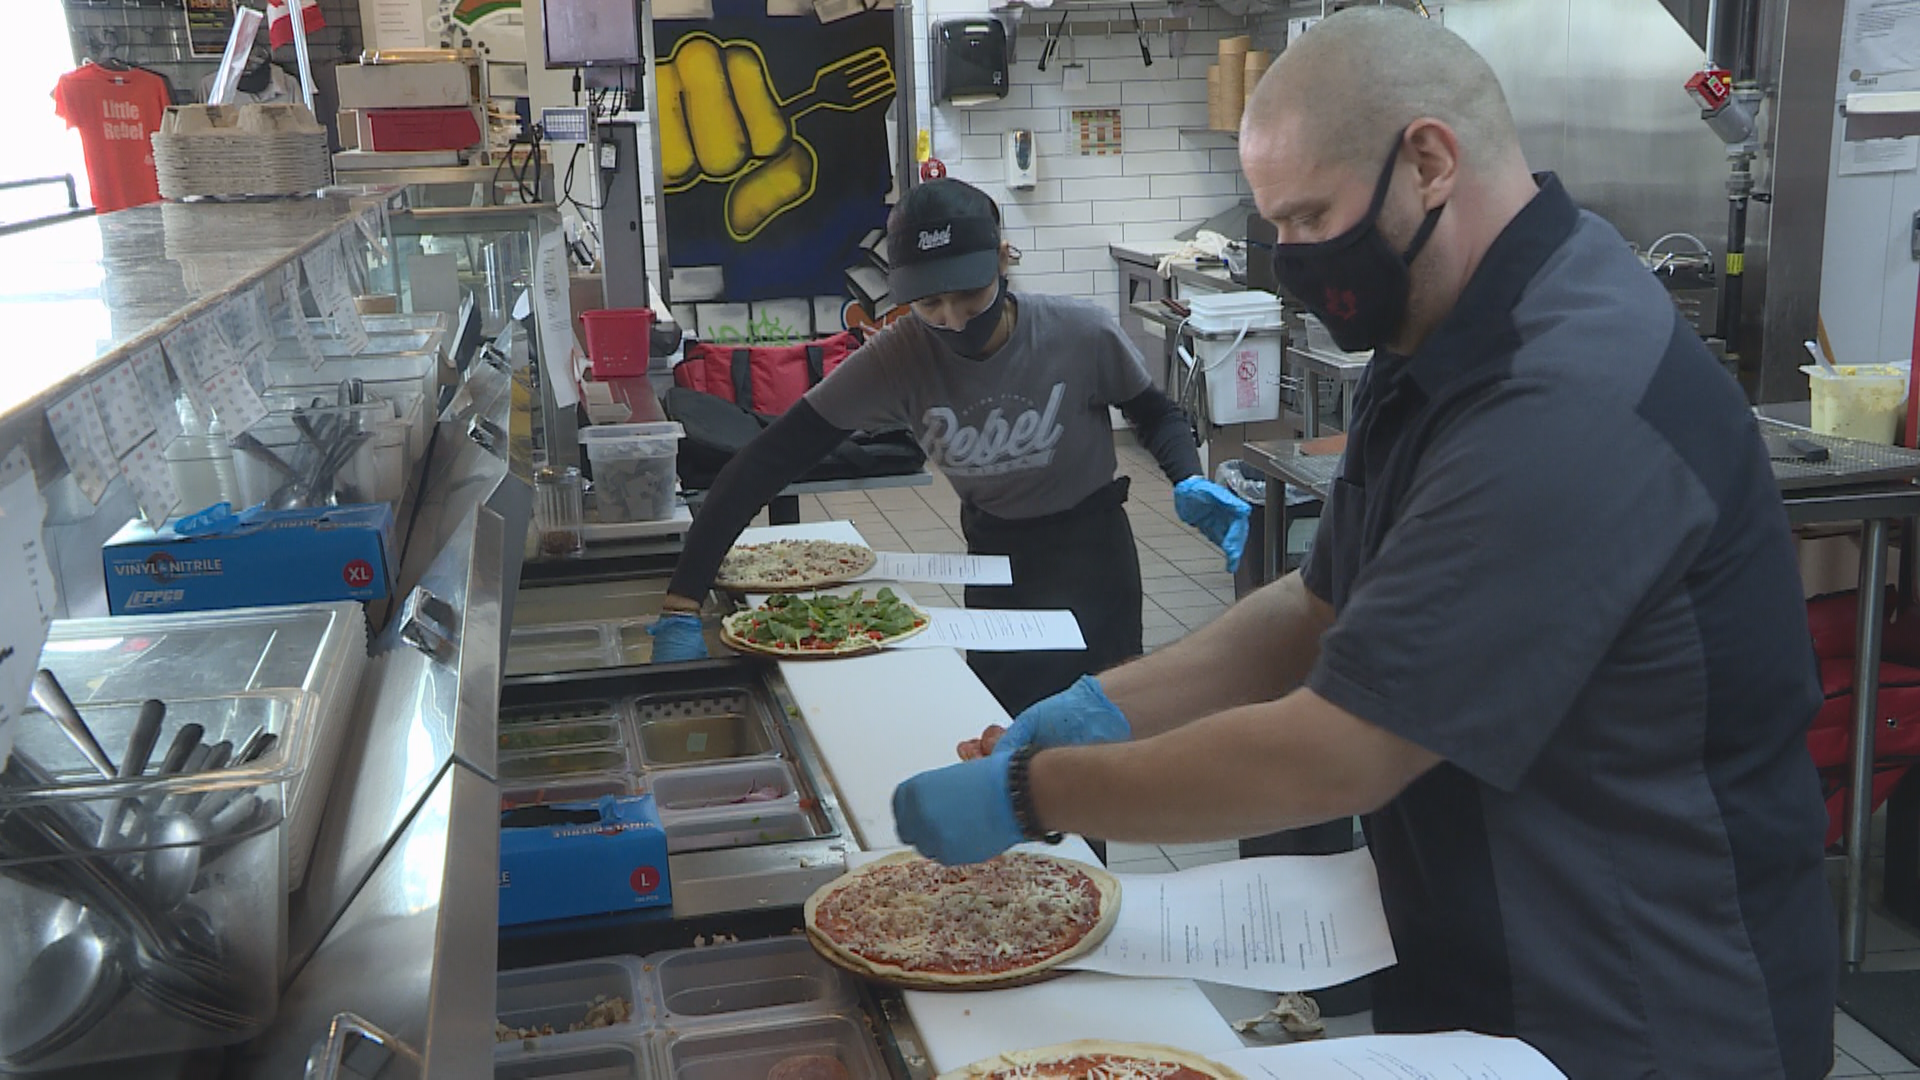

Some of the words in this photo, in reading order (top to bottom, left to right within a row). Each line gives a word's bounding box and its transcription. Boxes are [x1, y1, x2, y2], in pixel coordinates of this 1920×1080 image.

[102, 99, 140, 120] Little
[103, 121, 144, 140] Rebel
[918, 223, 951, 248] Rebel
[920, 381, 1066, 467] Rebel
[114, 562, 159, 576] VINYL
[169, 558, 222, 573] NITRILE
[347, 566, 370, 581] XL
[641, 872, 650, 887] L
